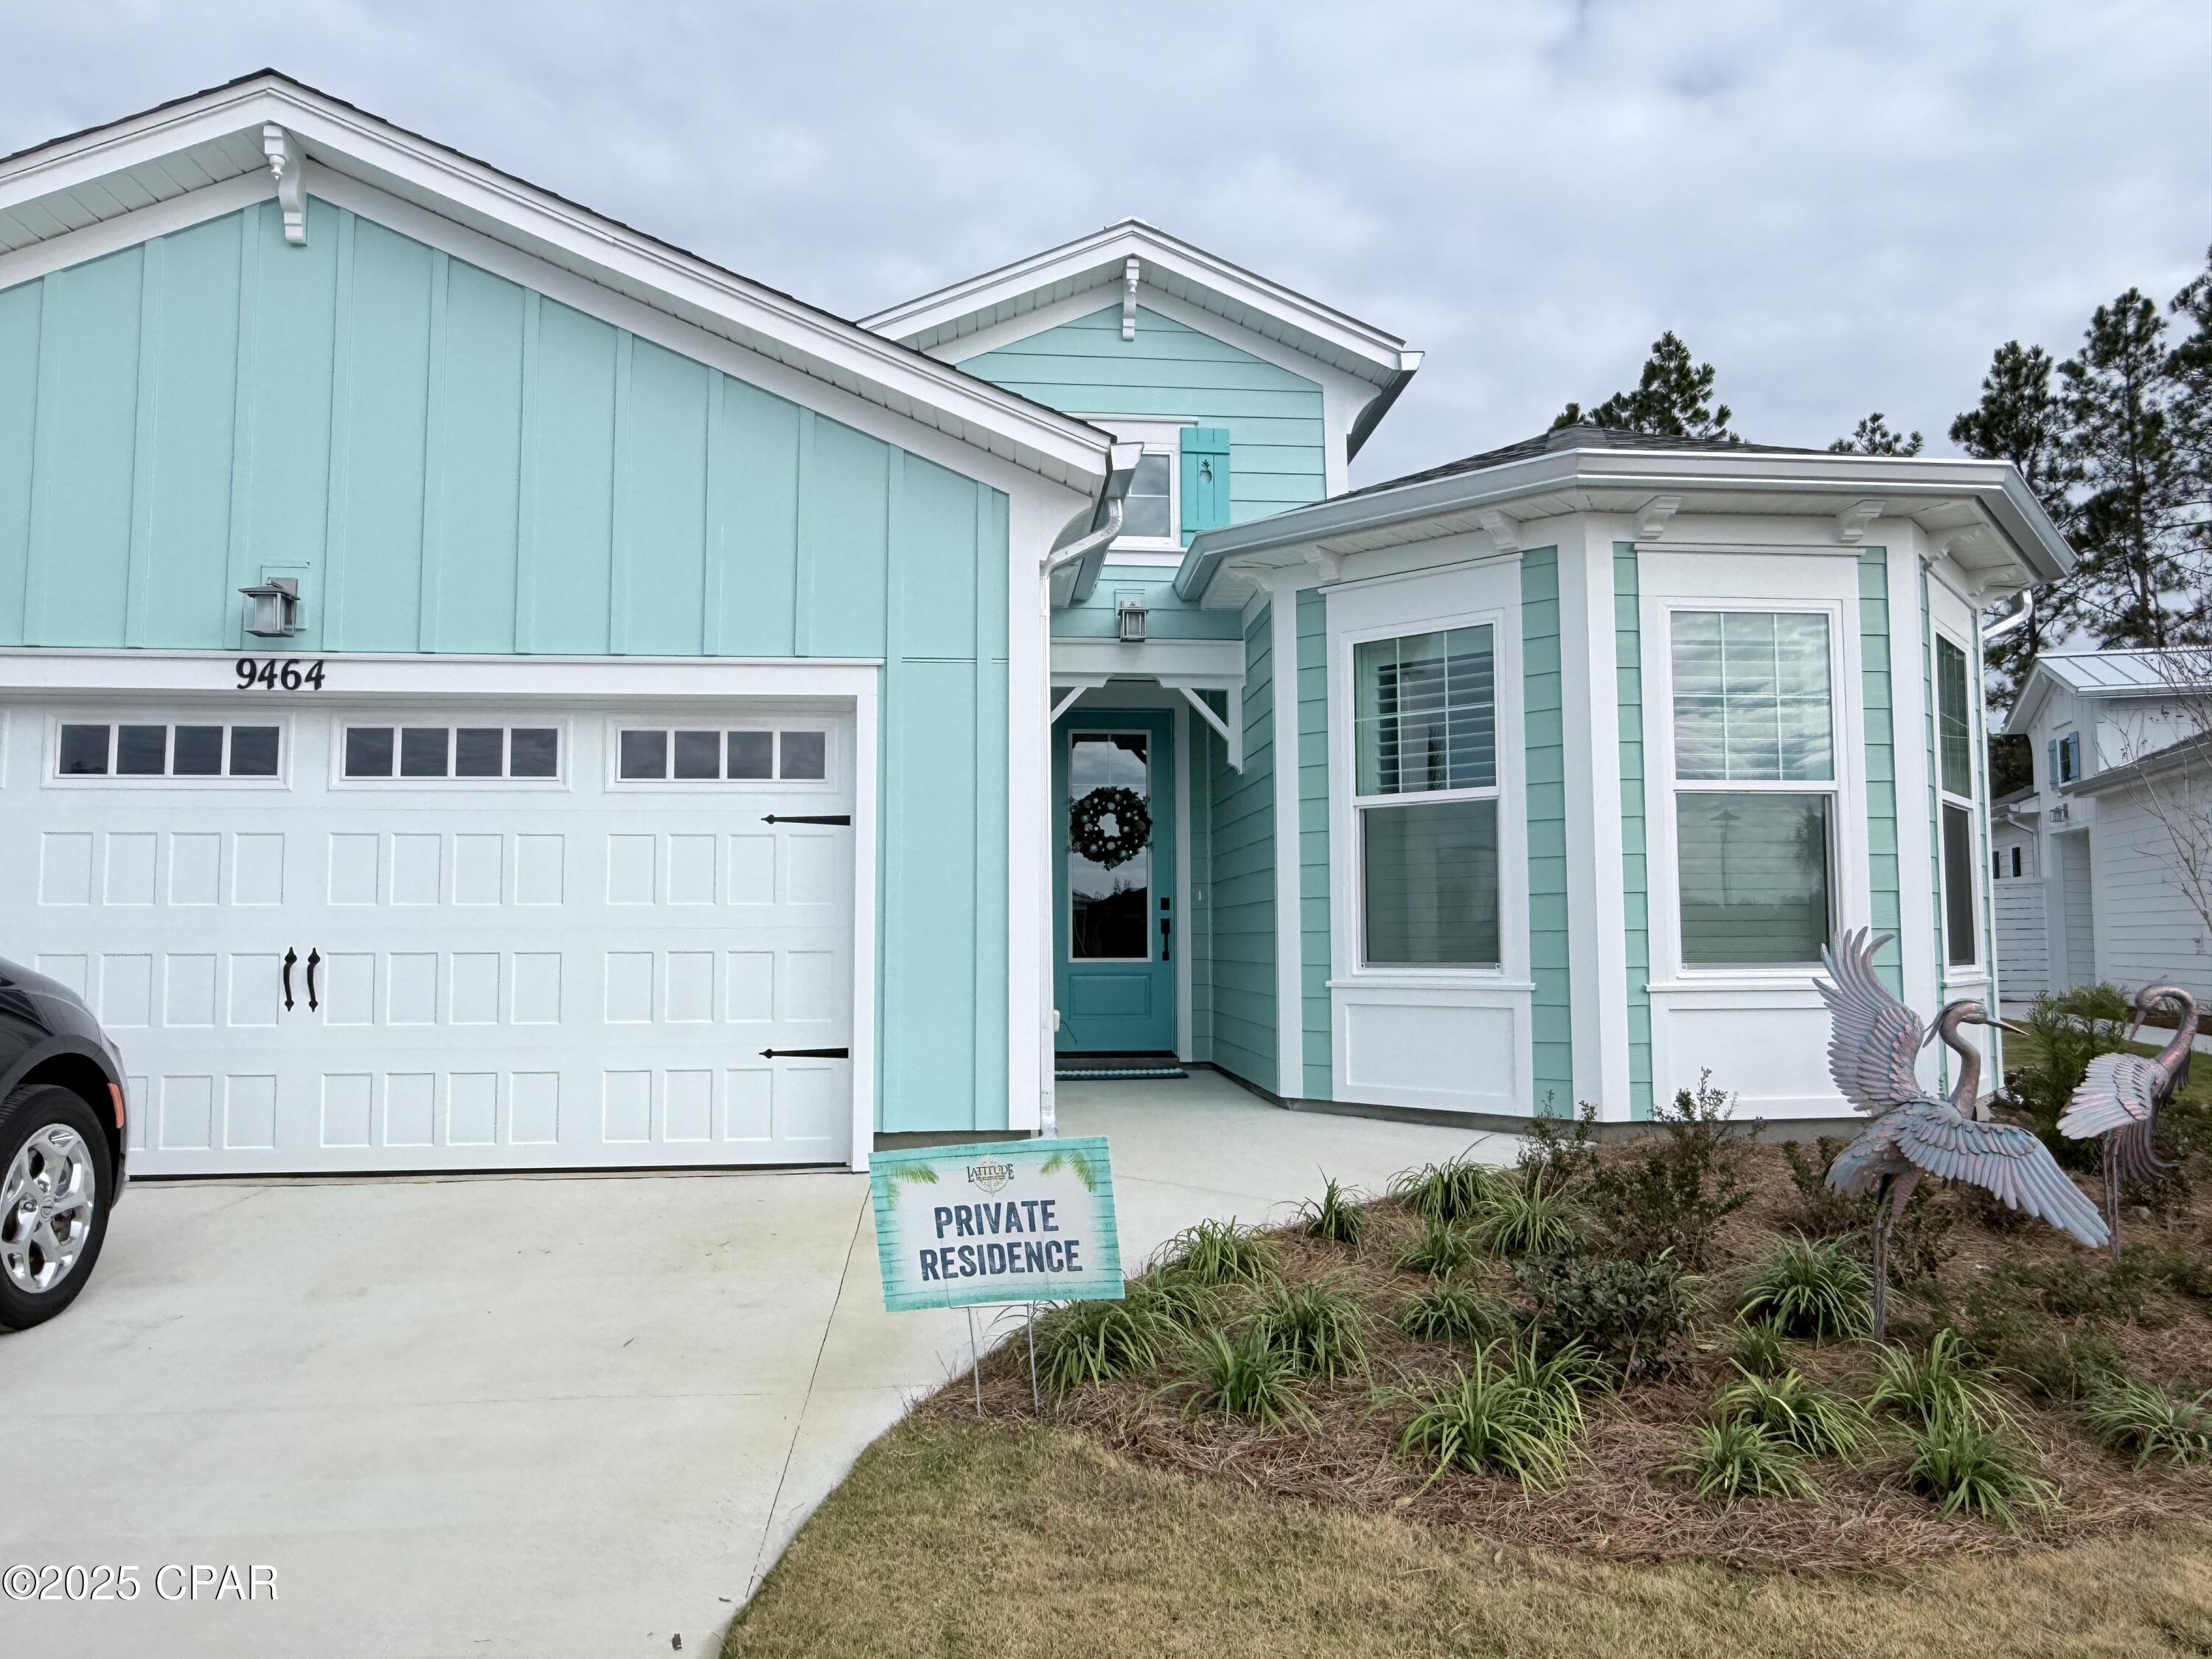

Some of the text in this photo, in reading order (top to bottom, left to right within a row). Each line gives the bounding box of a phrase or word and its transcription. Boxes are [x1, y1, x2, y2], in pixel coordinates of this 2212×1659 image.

[236, 658, 325, 690] 9464
[934, 1200, 1059, 1239] PRIVATE
[919, 1240, 1082, 1281] RESIDENCE
